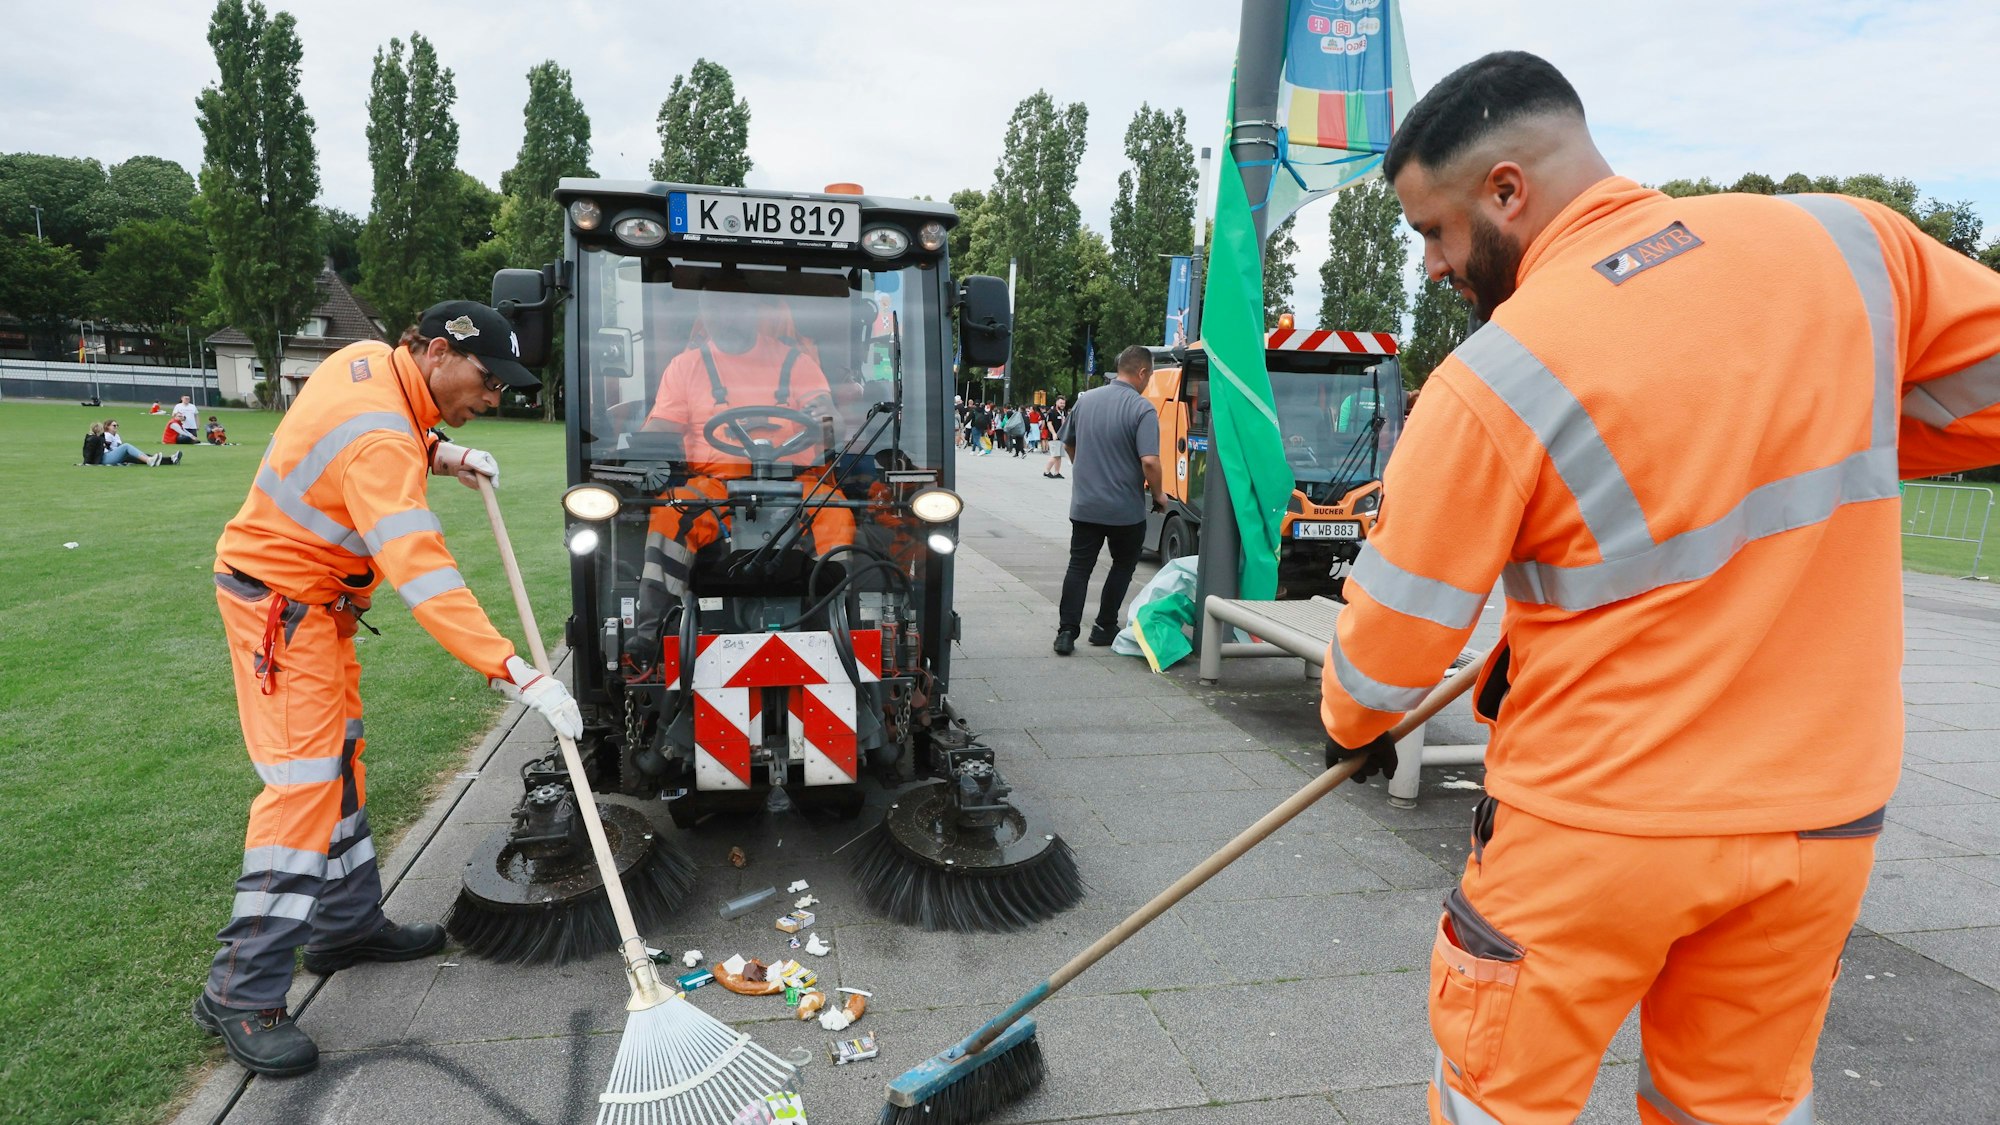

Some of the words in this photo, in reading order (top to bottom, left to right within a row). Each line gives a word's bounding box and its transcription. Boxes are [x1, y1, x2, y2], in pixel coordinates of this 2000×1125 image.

[675, 217, 683, 226] D
[700, 200, 719, 230] K
[742, 202, 781, 233] WB
[790, 205, 845, 237] 819
[1638, 228, 1693, 263] AWB
[1303, 524, 1311, 536] K
[1318, 524, 1332, 536] WB
[1334, 524, 1354, 536] 883
